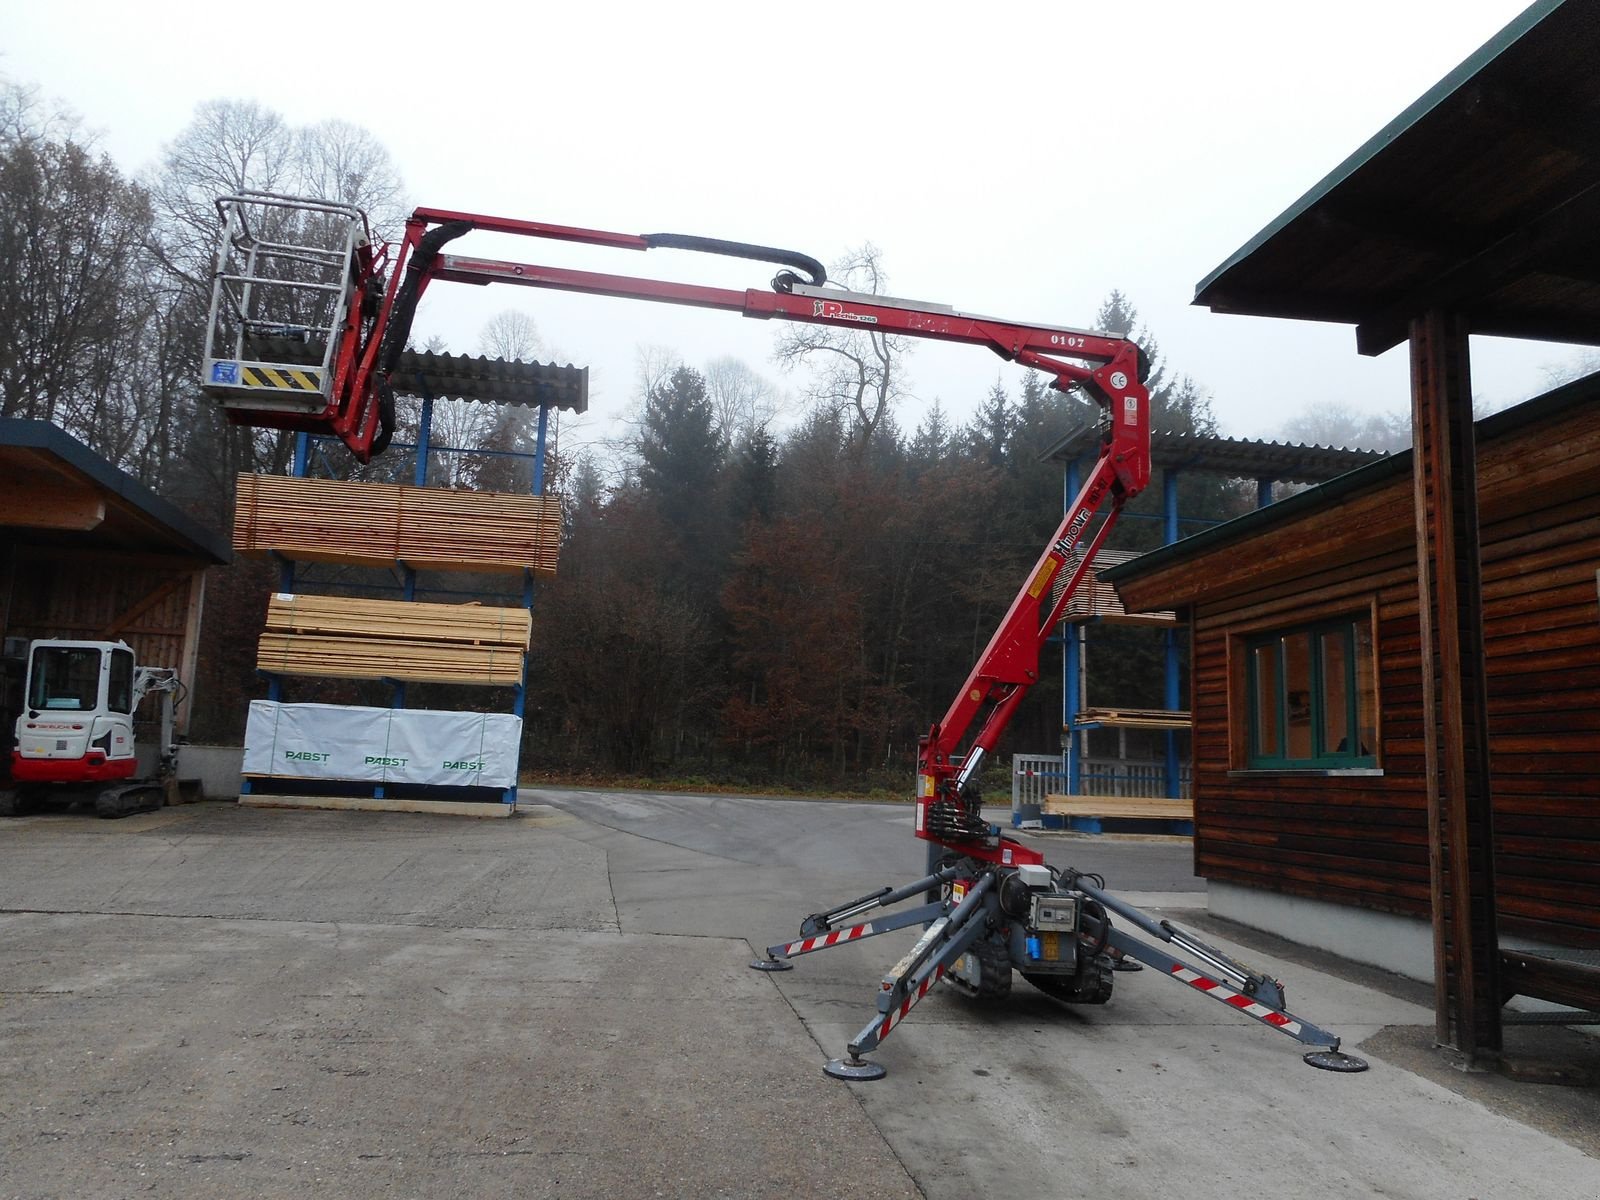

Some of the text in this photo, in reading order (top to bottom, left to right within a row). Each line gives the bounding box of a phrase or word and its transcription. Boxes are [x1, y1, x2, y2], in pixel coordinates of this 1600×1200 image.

[1051, 335, 1085, 348] 0107
[285, 750, 330, 762] PABST
[364, 756, 409, 767] PABST
[442, 760, 486, 771] PABST
